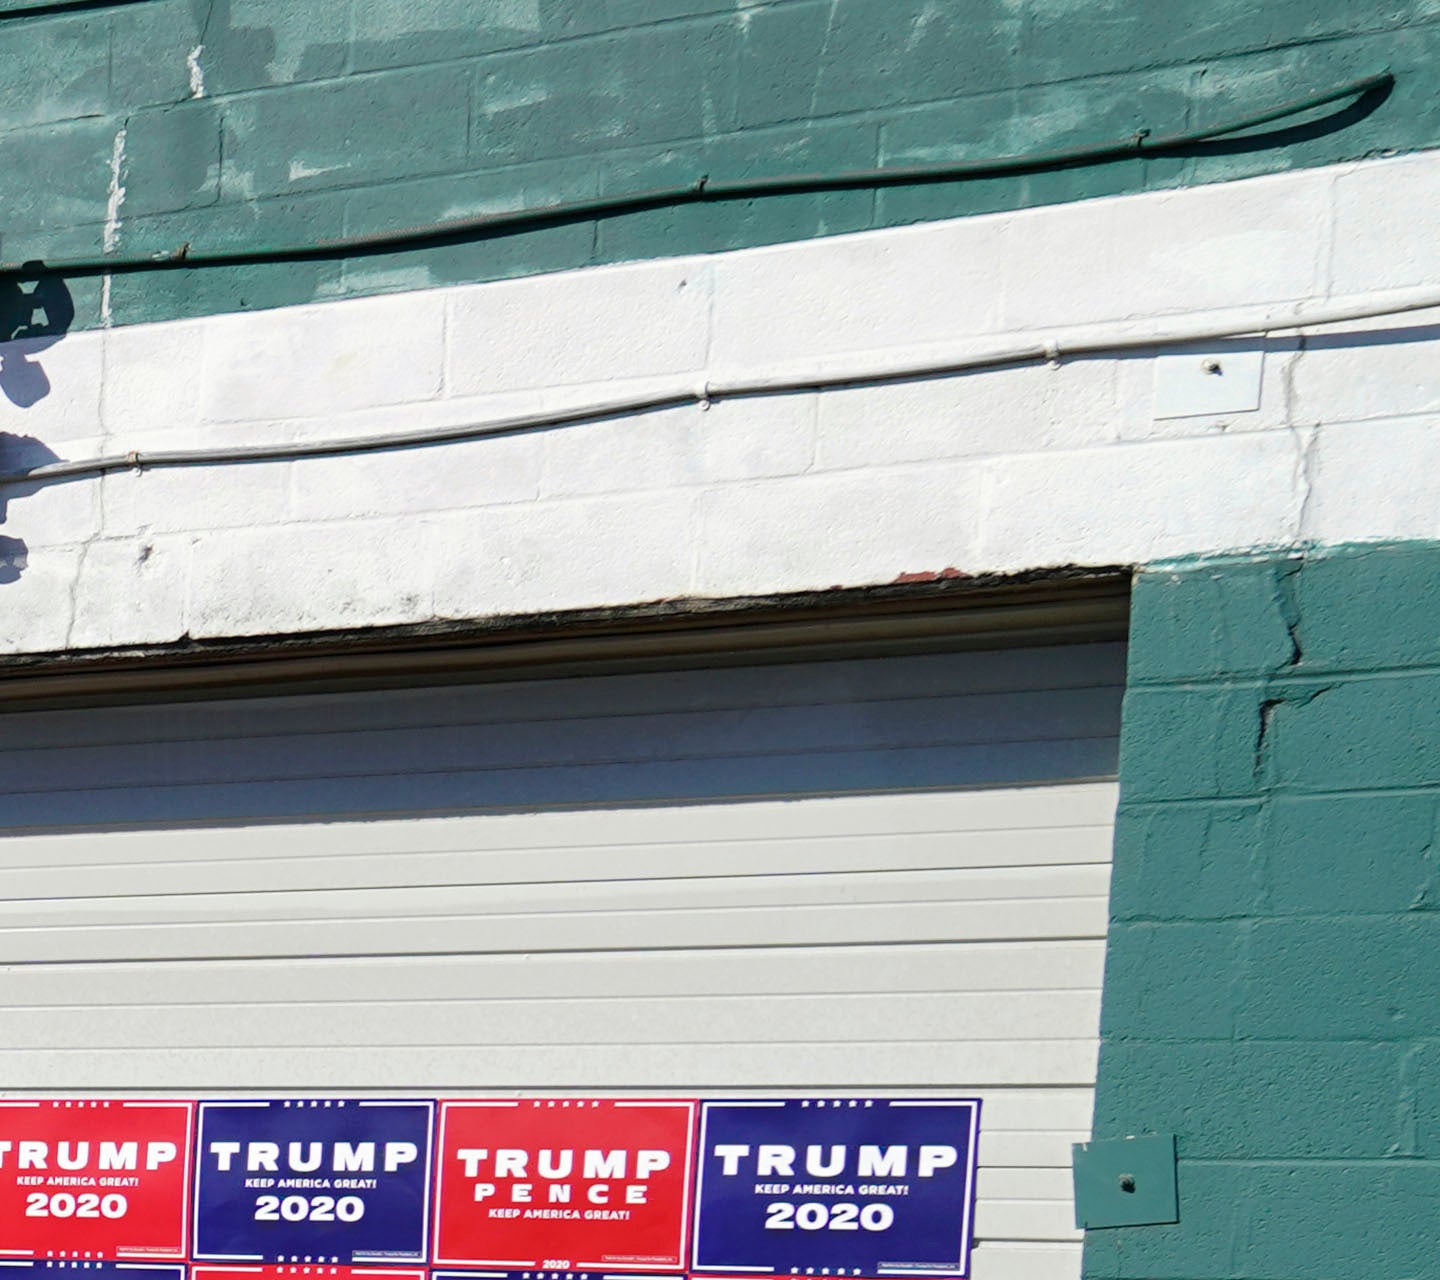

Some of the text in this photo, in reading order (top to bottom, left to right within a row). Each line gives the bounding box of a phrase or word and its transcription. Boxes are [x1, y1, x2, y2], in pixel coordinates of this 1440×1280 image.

[210, 1142, 417, 1171] TRUMP
[457, 1149, 670, 1179] TRUMP
[714, 1145, 957, 1177] TRUMP
[17, 1177, 138, 1186] KEEP AMERICA GREAT!
[246, 1179, 376, 1188] KEEP AMERICA GREAT!
[755, 1184, 908, 1195] KEEP AMERICA GREAT!
[475, 1184, 647, 1203] PENCE
[26, 1193, 127, 1218] 2020
[255, 1196, 364, 1222] 2020
[489, 1209, 629, 1219] KEEP AMERICA GREAT!
[765, 1203, 893, 1231] 2020
[543, 1260, 570, 1269] 2020
